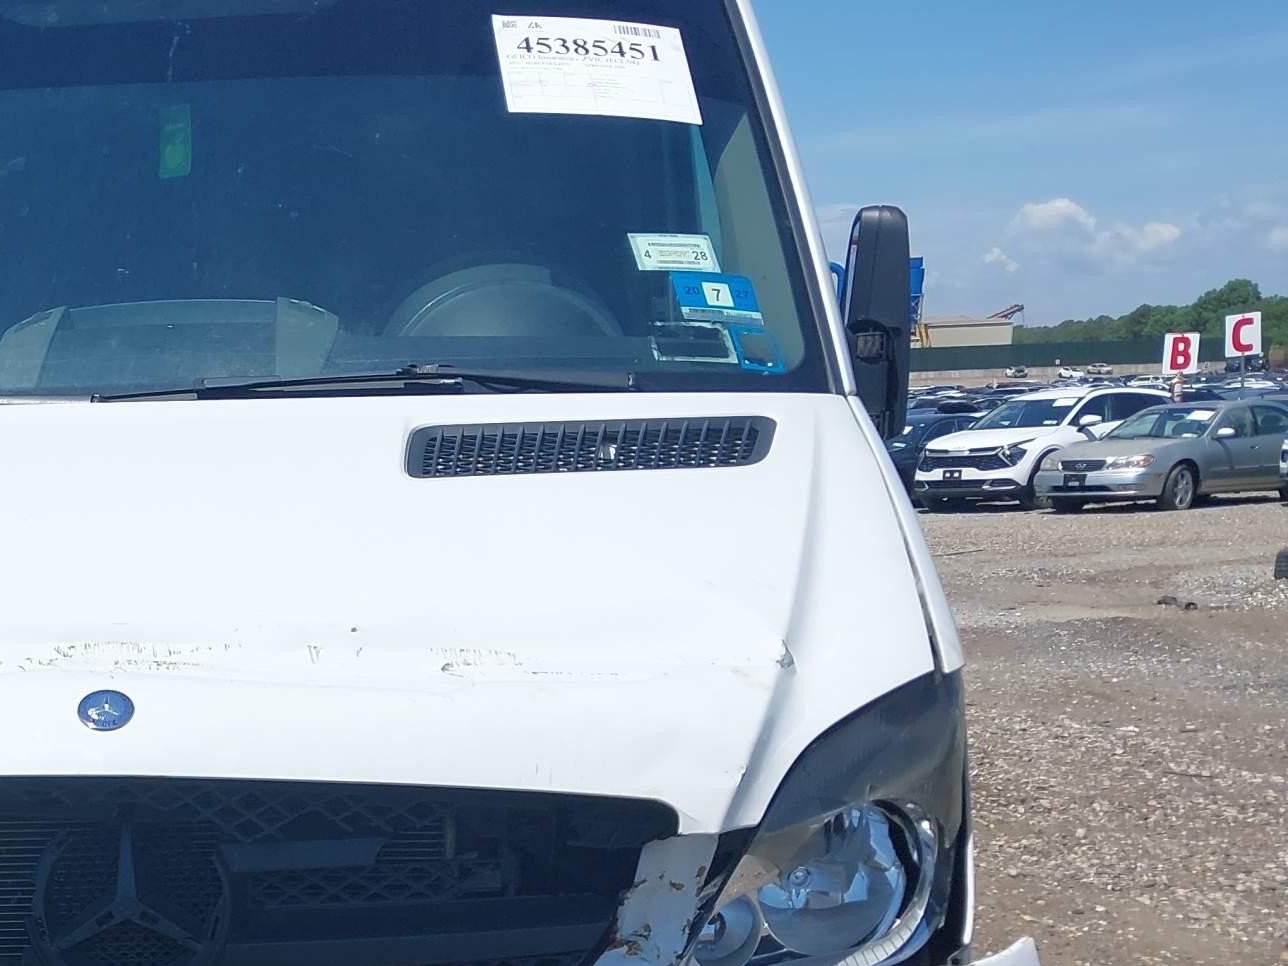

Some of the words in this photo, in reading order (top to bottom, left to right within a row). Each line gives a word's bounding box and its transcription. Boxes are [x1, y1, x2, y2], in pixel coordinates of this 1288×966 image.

[516, 36, 662, 62] 45385451
[643, 249, 652, 259] 4
[691, 250, 708, 261] 28
[711, 288, 721, 302] 7
[1231, 317, 1255, 353] C
[1169, 336, 1192, 371] B
